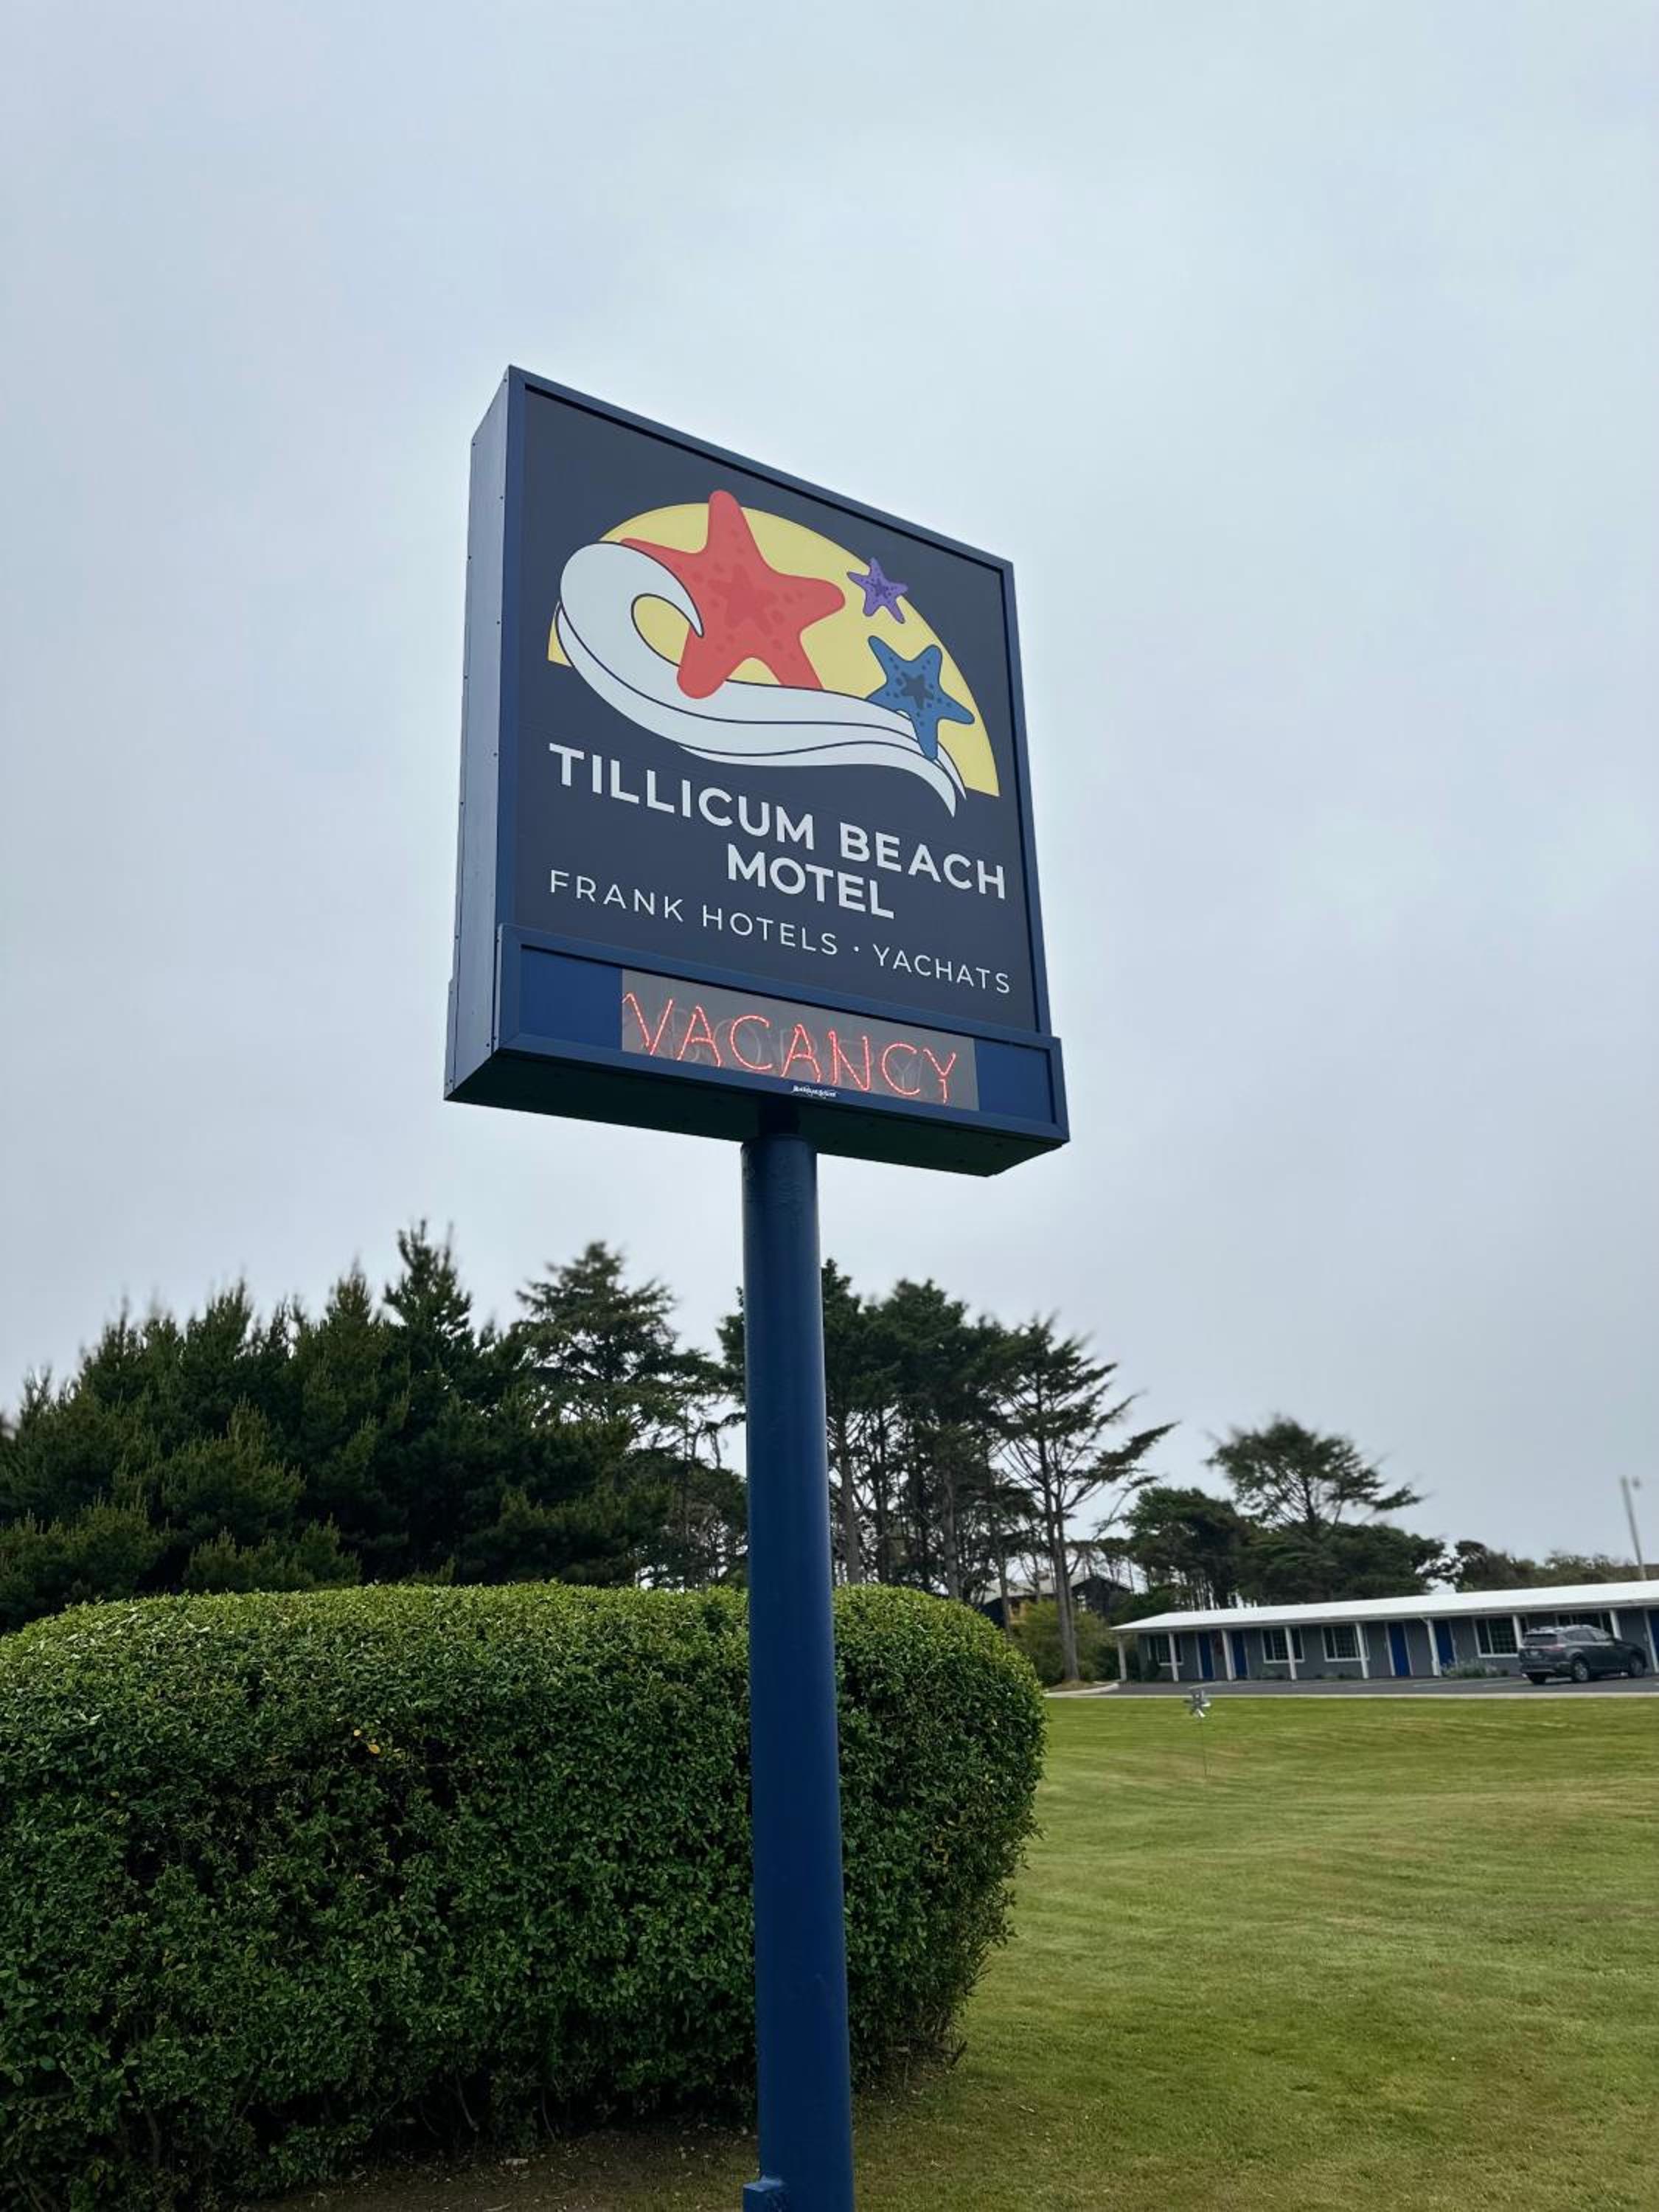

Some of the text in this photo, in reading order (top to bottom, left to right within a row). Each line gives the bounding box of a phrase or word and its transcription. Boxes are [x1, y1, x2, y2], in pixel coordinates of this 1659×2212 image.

[549, 742, 1006, 900] TILLICUM BEACH
[549, 869, 684, 922] FRANK
[702, 904, 838, 956] HOTELS
[872, 943, 1010, 994] YACHATS
[727, 843, 894, 919] MOTEL
[621, 992, 957, 1105] VACANCY
